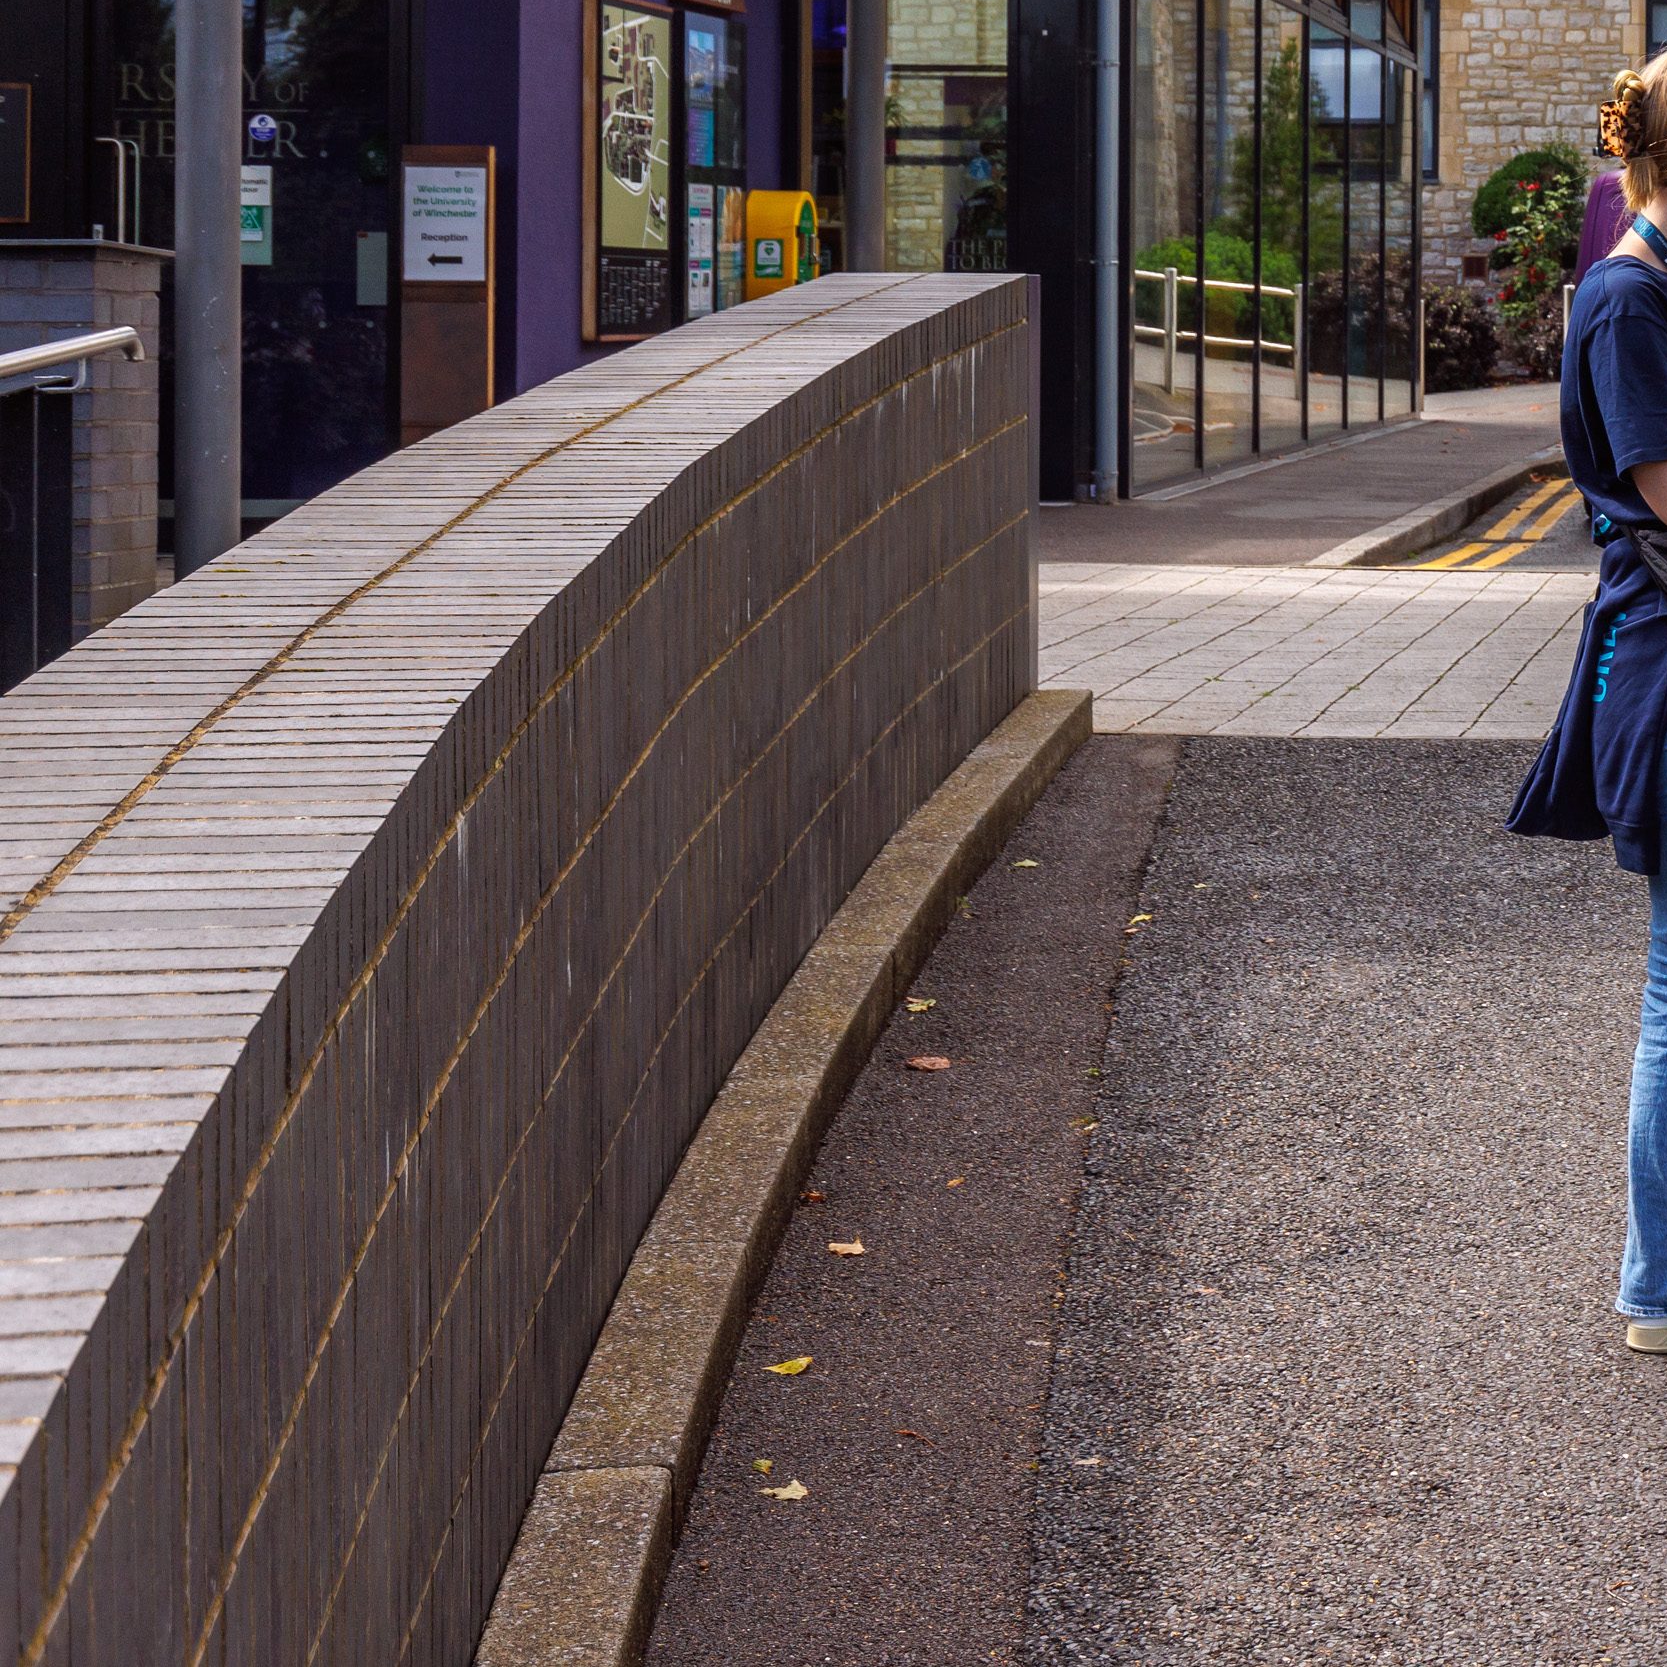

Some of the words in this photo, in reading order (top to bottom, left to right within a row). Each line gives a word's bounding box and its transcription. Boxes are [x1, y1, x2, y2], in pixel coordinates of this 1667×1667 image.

[416, 184, 461, 193] Welcome
[464, 185, 474, 193] to
[413, 197, 428, 205] the
[430, 197, 477, 207] University
[412, 209, 421, 217] of
[424, 209, 477, 217] Winchester
[421, 232, 468, 243] Reception
